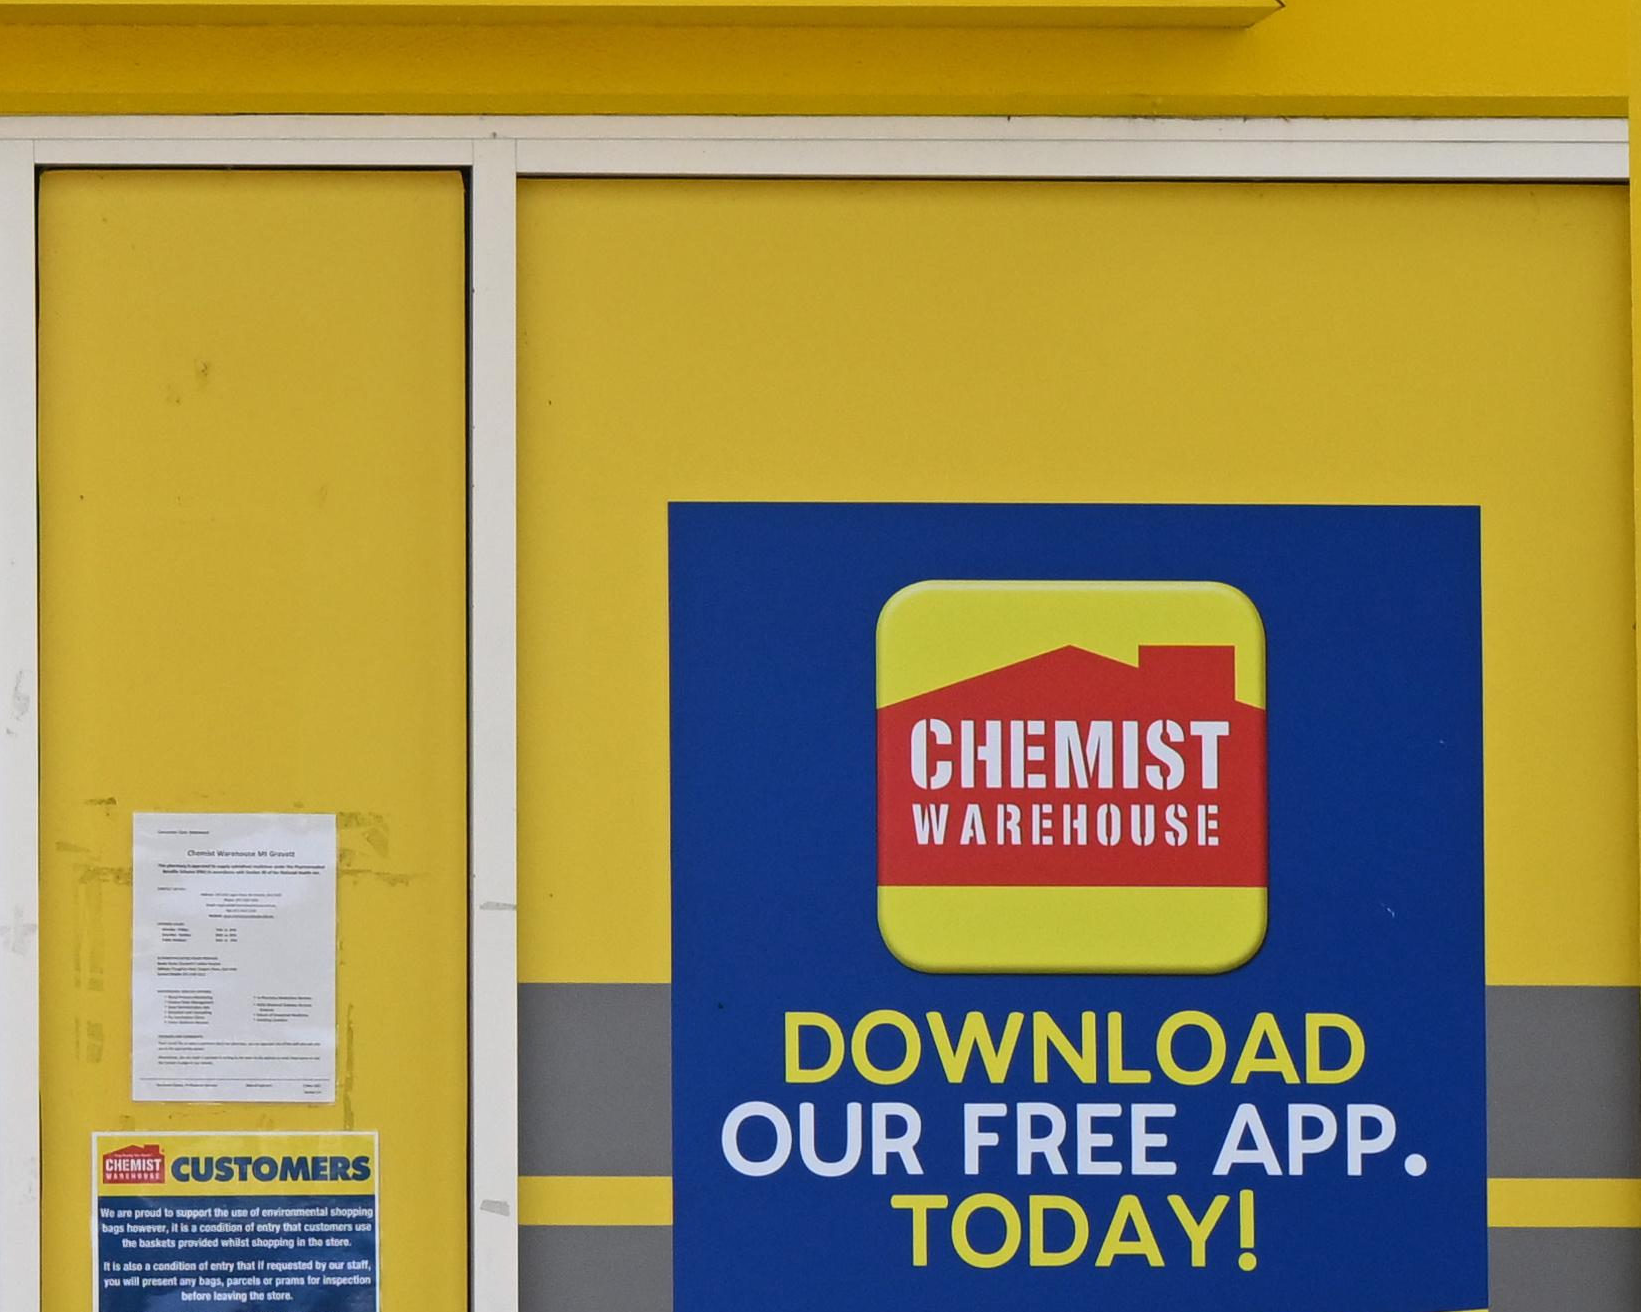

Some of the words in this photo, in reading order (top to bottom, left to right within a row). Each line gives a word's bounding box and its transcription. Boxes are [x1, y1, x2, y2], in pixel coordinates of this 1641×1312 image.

[909, 717, 1230, 792] CHEMIST
[912, 802, 1222, 848] WAREHOUSE
[783, 1010, 1367, 1087] DOWNLOAD
[720, 1101, 923, 1178] OUR
[963, 1102, 1178, 1177] FREE
[1212, 1102, 1429, 1178] APP.
[106, 1159, 162, 1172] CHEMIST
[170, 1155, 372, 1183] CUSTOMERS
[101, 1208, 115, 1218] We
[117, 1210, 132, 1218] are
[135, 1207, 162, 1219] proud
[176, 1208, 212, 1219] support
[214, 1208, 229, 1217] the
[232, 1209, 248, 1217] use
[262, 1207, 328, 1217] environmental
[330, 1206, 373, 1218] shopping
[102, 1223, 124, 1235] bags
[200, 1222, 243, 1232] condition
[257, 1223, 280, 1233] entry
[283, 1222, 301, 1232] that
[304, 1223, 353, 1232] customers
[355, 1223, 371, 1231] use
[889, 1188, 1259, 1272] TODAY!
[122, 1238, 137, 1248] the
[139, 1238, 175, 1248] baskets
[178, 1238, 218, 1249] provided
[221, 1238, 249, 1247] whilst
[252, 1237, 294, 1249] shopping
[308, 1237, 322, 1247] the
[123, 1261, 142, 1271] also
[153, 1261, 196, 1271] condition
[211, 1261, 234, 1272] entry
[237, 1261, 255, 1270] that
[267, 1260, 313, 1272] requested
[315, 1260, 327, 1271] by
[329, 1262, 344, 1270] our
[104, 1278, 121, 1288] you
[123, 1276, 139, 1286] will
[142, 1277, 177, 1288] present
[180, 1278, 196, 1287] any
[226, 1276, 261, 1289] parcels
[275, 1277, 305, 1287] prams
[307, 1275, 320, 1285] for
[323, 1274, 370, 1286] inspection
[182, 1291, 211, 1301] before
[214, 1291, 247, 1302] leaving
[250, 1291, 264, 1300] the
